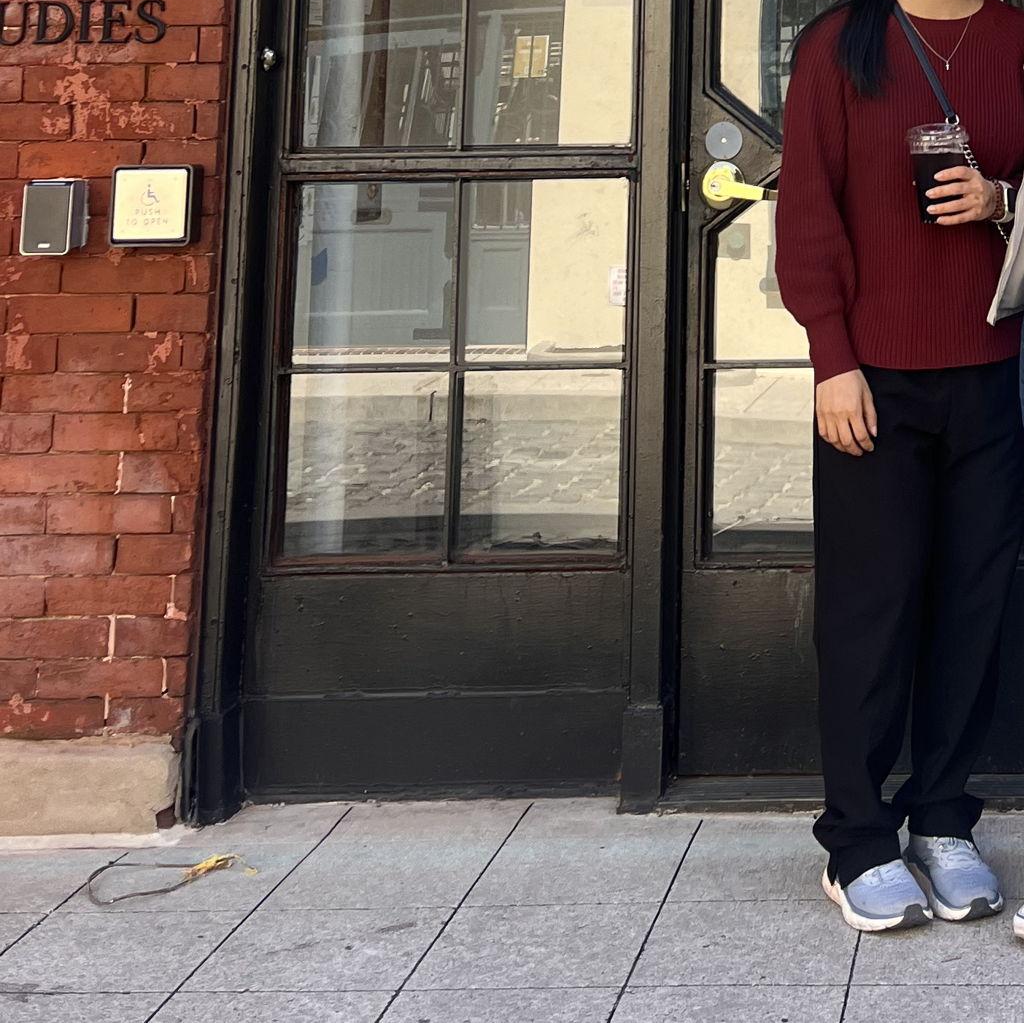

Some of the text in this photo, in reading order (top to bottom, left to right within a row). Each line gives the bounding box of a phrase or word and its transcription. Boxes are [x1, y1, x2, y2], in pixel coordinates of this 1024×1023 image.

[135, 208, 161, 216] PUSH
[126, 217, 168, 226] TO OPEN
